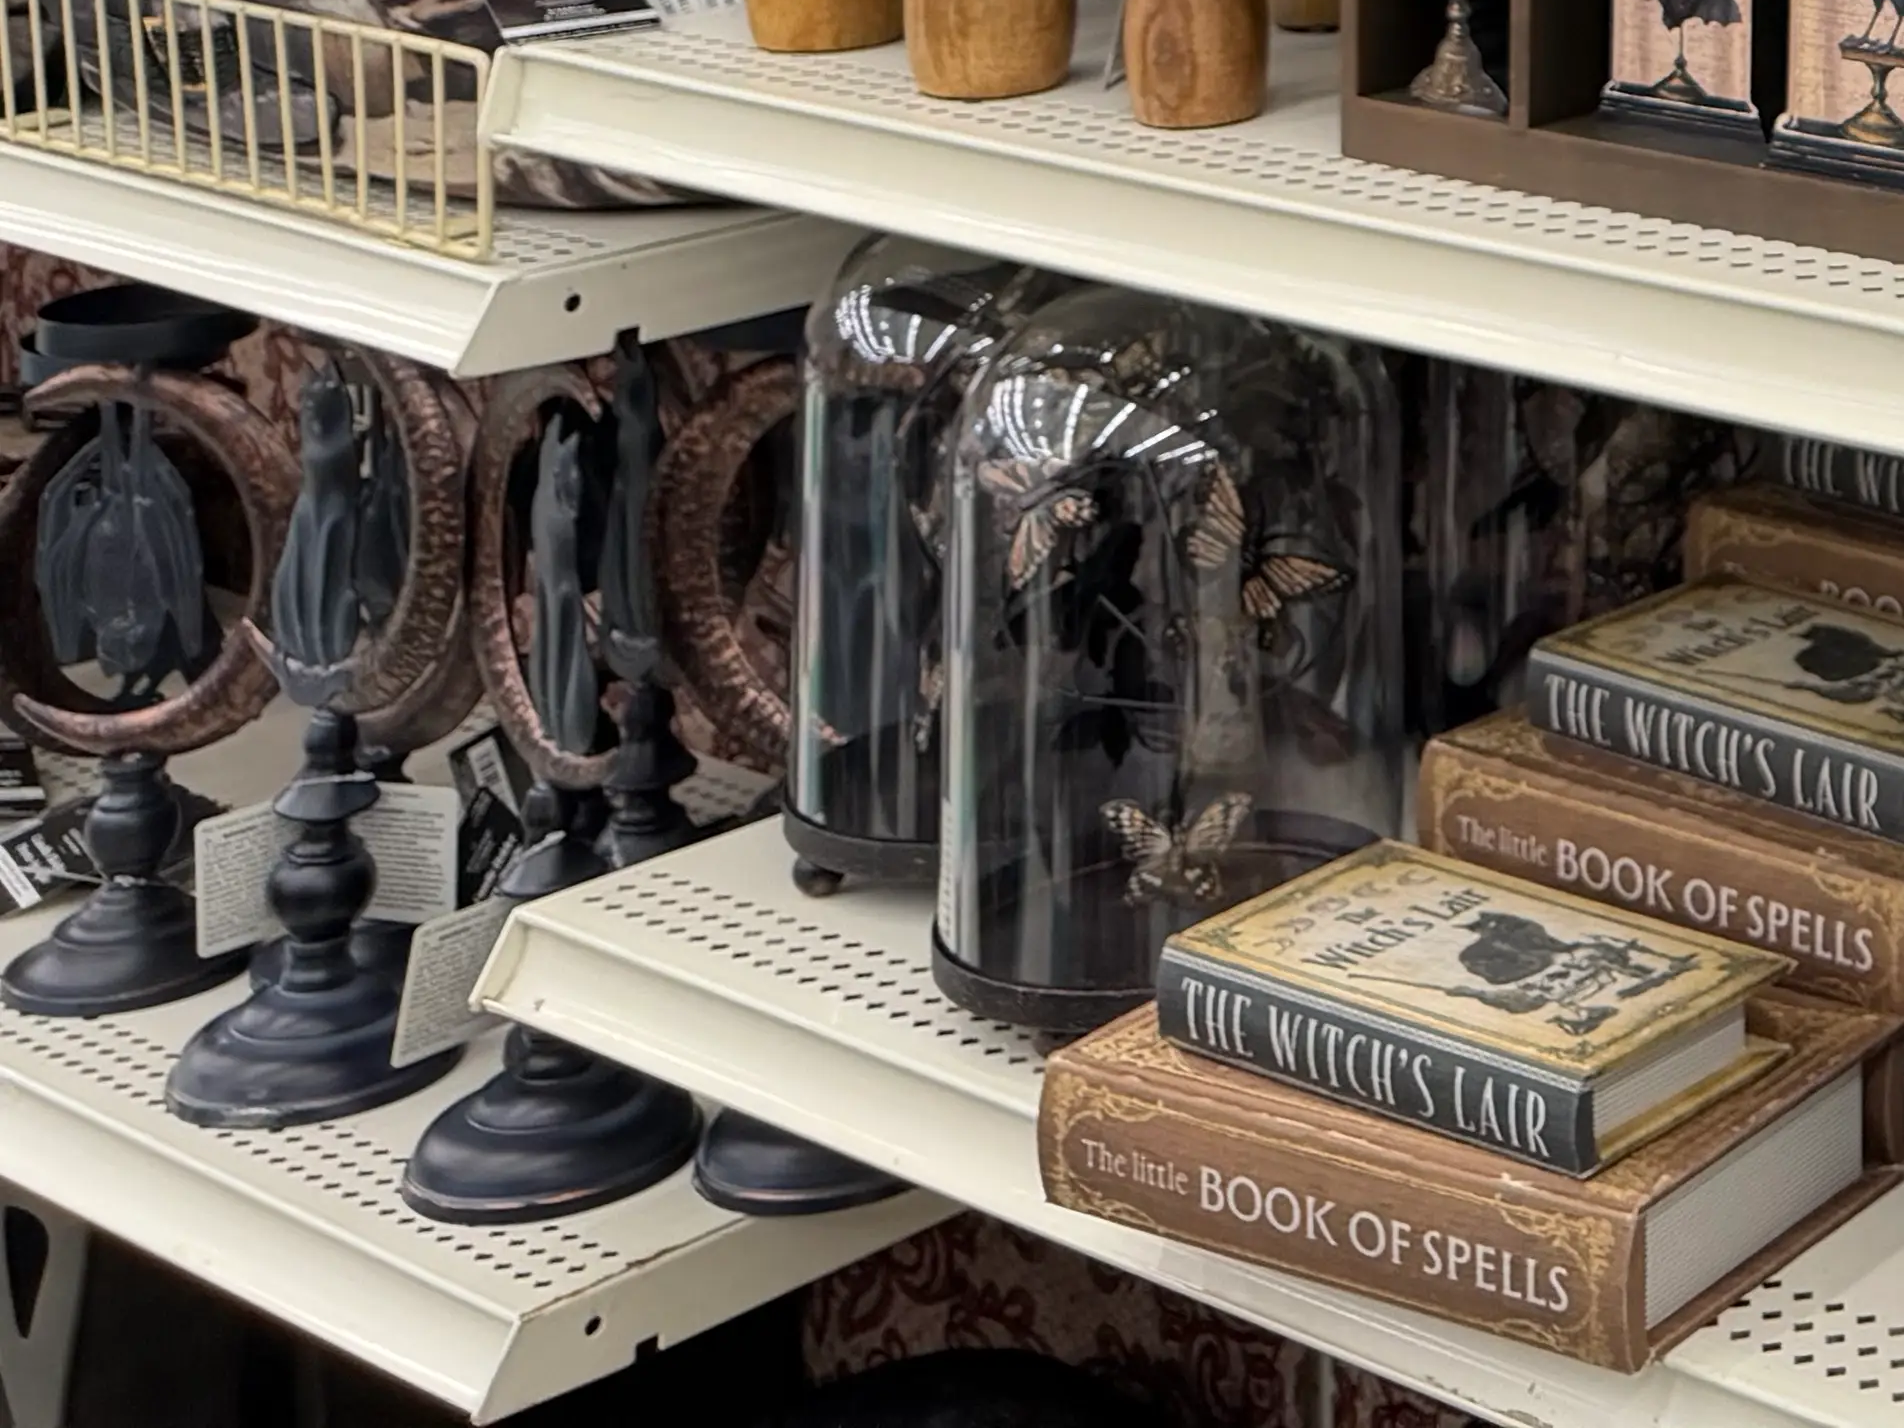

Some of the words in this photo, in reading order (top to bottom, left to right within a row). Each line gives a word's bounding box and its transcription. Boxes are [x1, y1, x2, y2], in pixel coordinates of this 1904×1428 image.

[1783, 437, 1843, 496] THE
[1545, 674, 1611, 746] THE
[1624, 697, 1776, 799] WITCH'S
[1793, 748, 1882, 830] LAIR
[1301, 904, 1435, 971] Witch's
[1427, 887, 1493, 920] Lair
[1456, 814, 1498, 845] The
[1498, 825, 1549, 868] little
[1555, 838, 1676, 913] BOOK
[1682, 878, 1739, 928] OF
[1746, 894, 1875, 973] SPELLS
[1181, 976, 1254, 1058] THE
[1268, 1004, 1435, 1119] WITCH'S
[1453, 1065, 1551, 1158] LAIR
[1081, 1138, 1128, 1176] The
[1131, 1149, 1189, 1196] little
[1199, 1165, 1338, 1246] BOOK
[1348, 1210, 1412, 1265] OF
[1423, 1229, 1570, 1313] SPELLS
